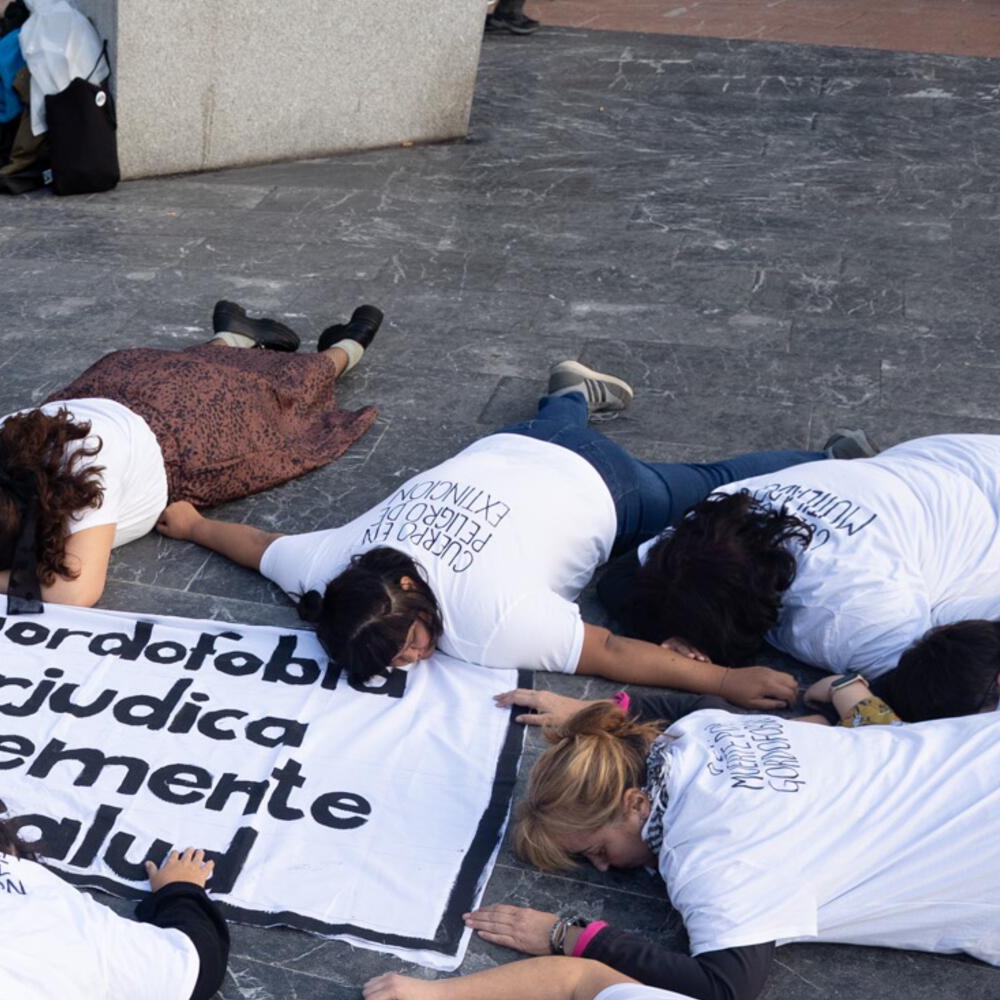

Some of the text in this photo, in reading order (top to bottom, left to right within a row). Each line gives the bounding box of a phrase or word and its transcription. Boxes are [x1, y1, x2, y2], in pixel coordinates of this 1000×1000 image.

[361, 522, 474, 573] CUERPO EN
[371, 503, 492, 553] PELIGRO DE
